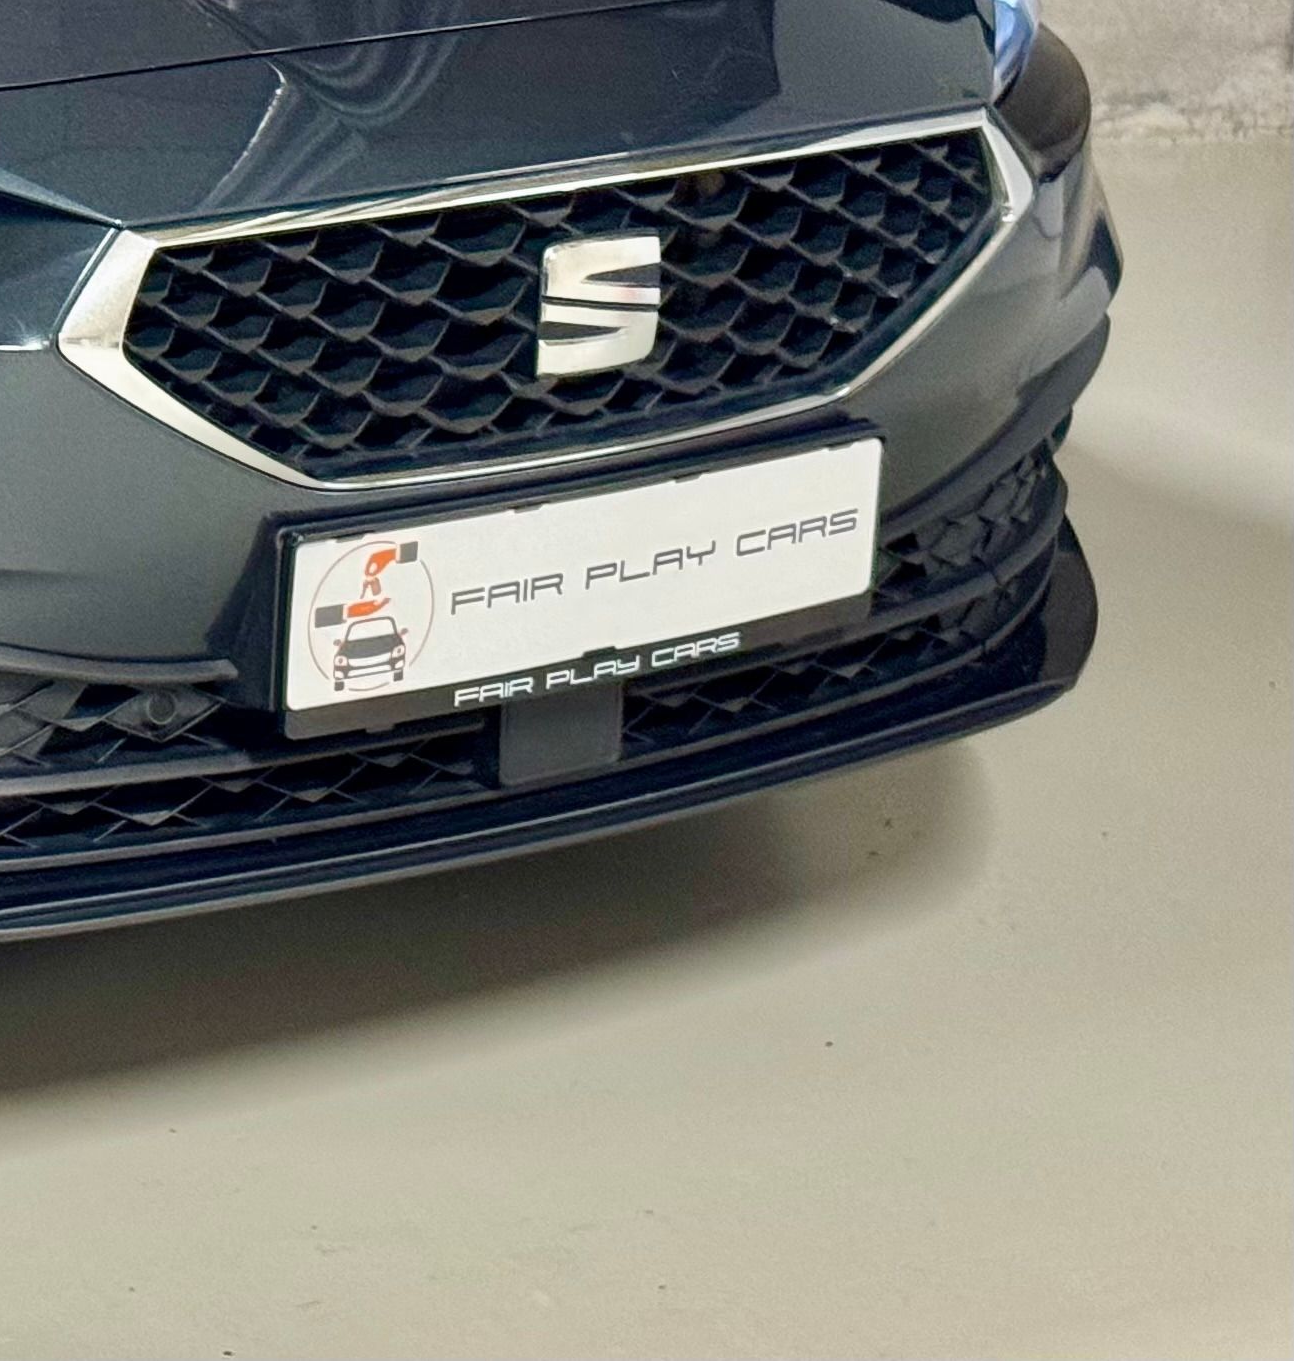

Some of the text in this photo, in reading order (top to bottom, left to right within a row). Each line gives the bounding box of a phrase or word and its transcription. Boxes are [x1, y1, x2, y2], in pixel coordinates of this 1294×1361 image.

[450, 508, 860, 616] FAIR PLAY CARS
[453, 631, 742, 708] FAIR PLAY CARS
